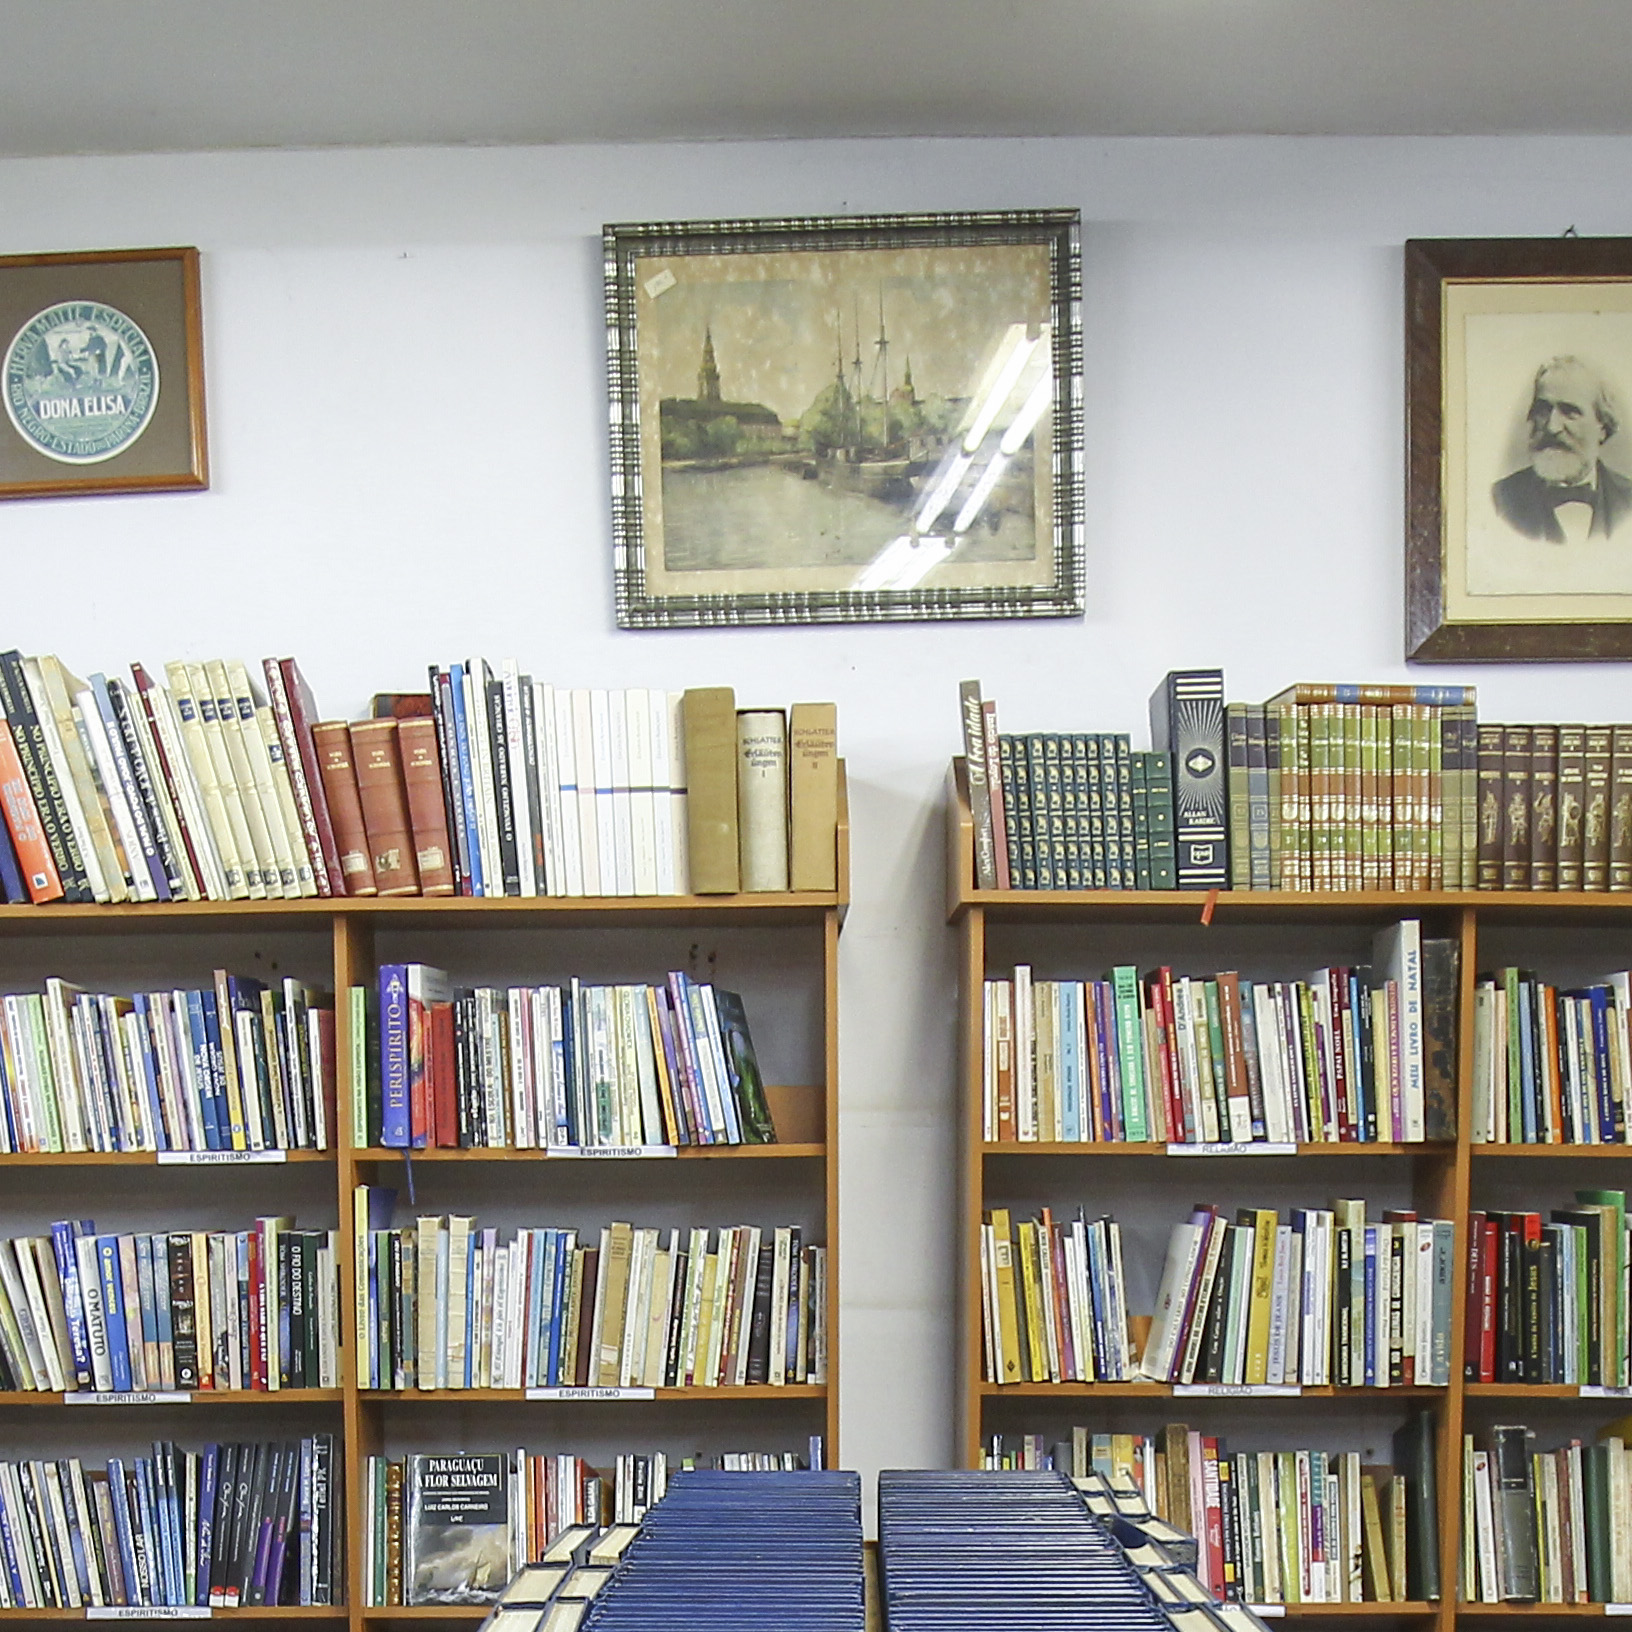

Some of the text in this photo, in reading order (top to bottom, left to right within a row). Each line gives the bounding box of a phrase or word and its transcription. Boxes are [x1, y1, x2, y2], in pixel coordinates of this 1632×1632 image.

[39, 395, 125, 419] DONA ELISA
[1405, 949, 1418, 1068] LIVRO NATAL
[189, 1152, 252, 1163] ESPIRITISMO
[579, 1147, 643, 1158] ESPIRITISMO
[89, 1300, 106, 1357] MATUTO
[95, 1392, 157, 1404] ESPIRITISMO
[557, 1388, 621, 1399] ESPIRITISMO
[429, 1458, 484, 1475] PARAGUAÇU
[425, 1473, 498, 1488] FLOR SELVAGEM
